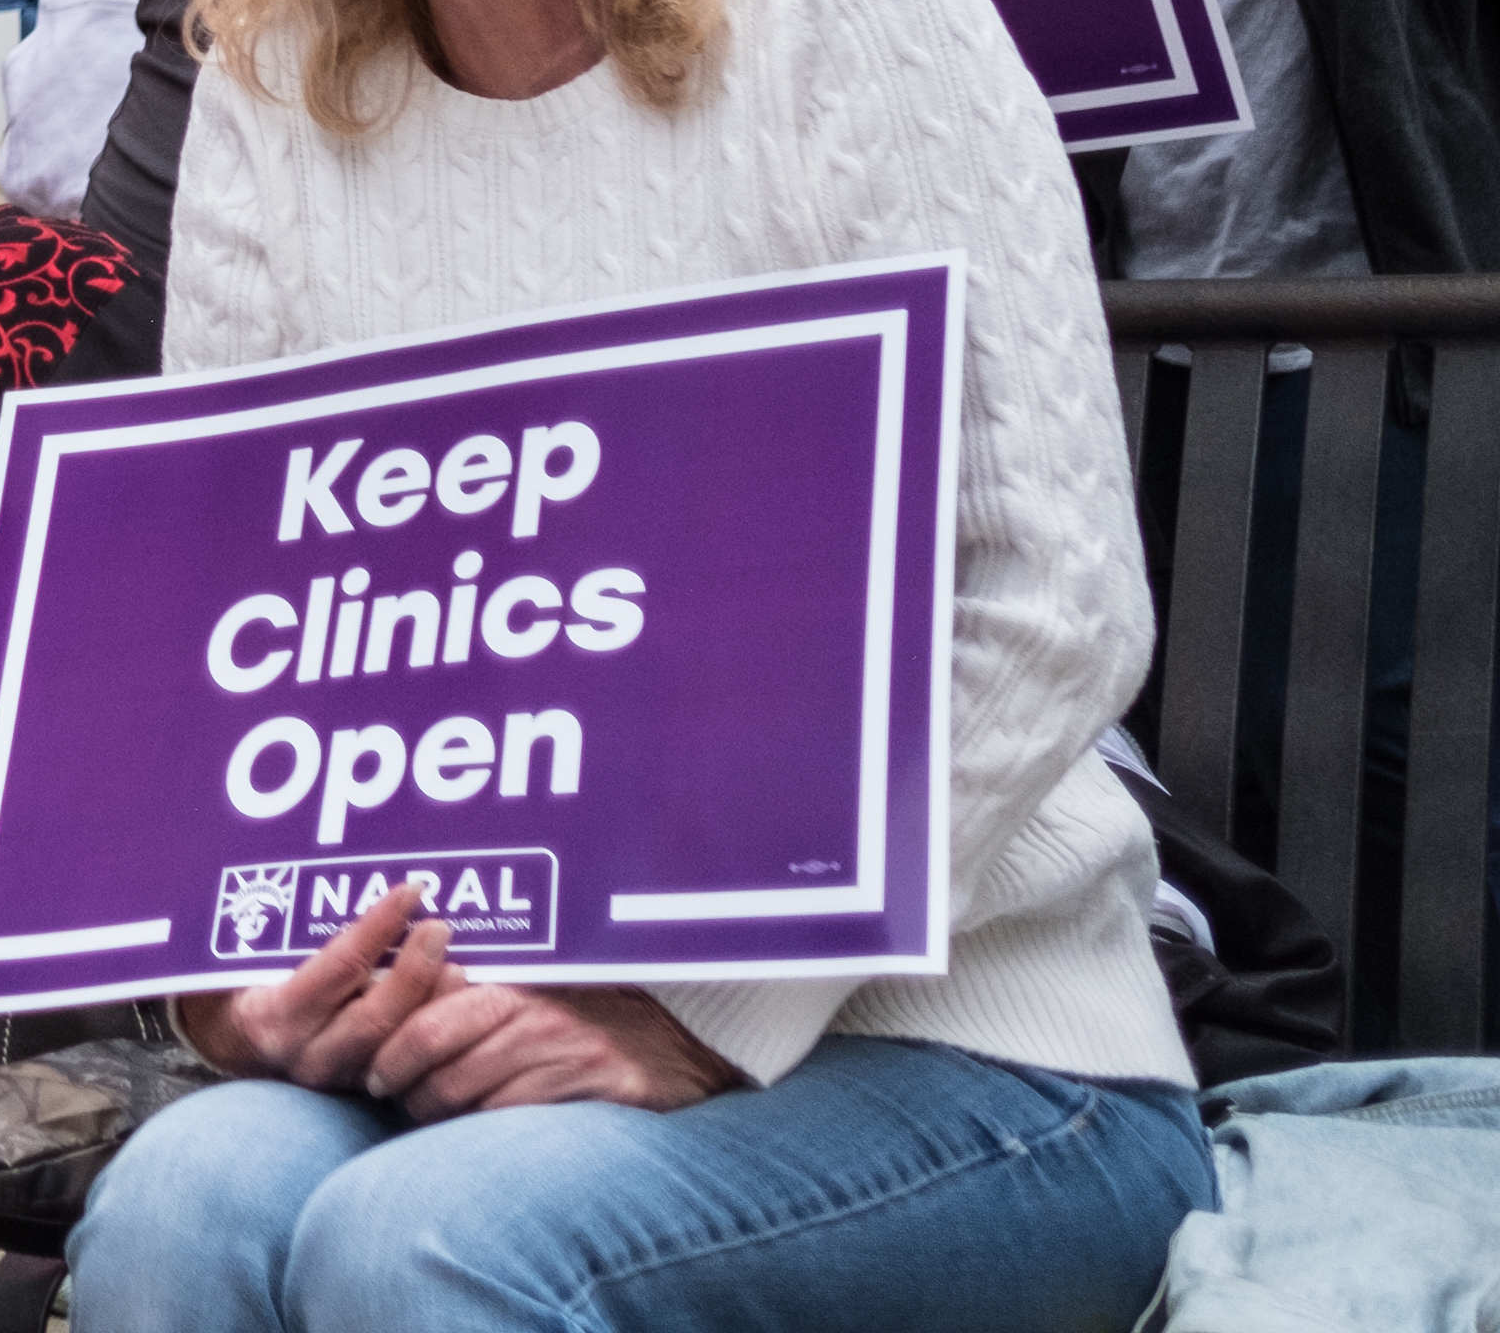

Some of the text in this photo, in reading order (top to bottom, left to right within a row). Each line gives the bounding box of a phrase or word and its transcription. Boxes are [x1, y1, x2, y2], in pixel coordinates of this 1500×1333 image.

[277, 417, 602, 542] Keep
[206, 550, 648, 692] Clinics
[226, 707, 583, 845] Open
[311, 867, 532, 918] NARAL
